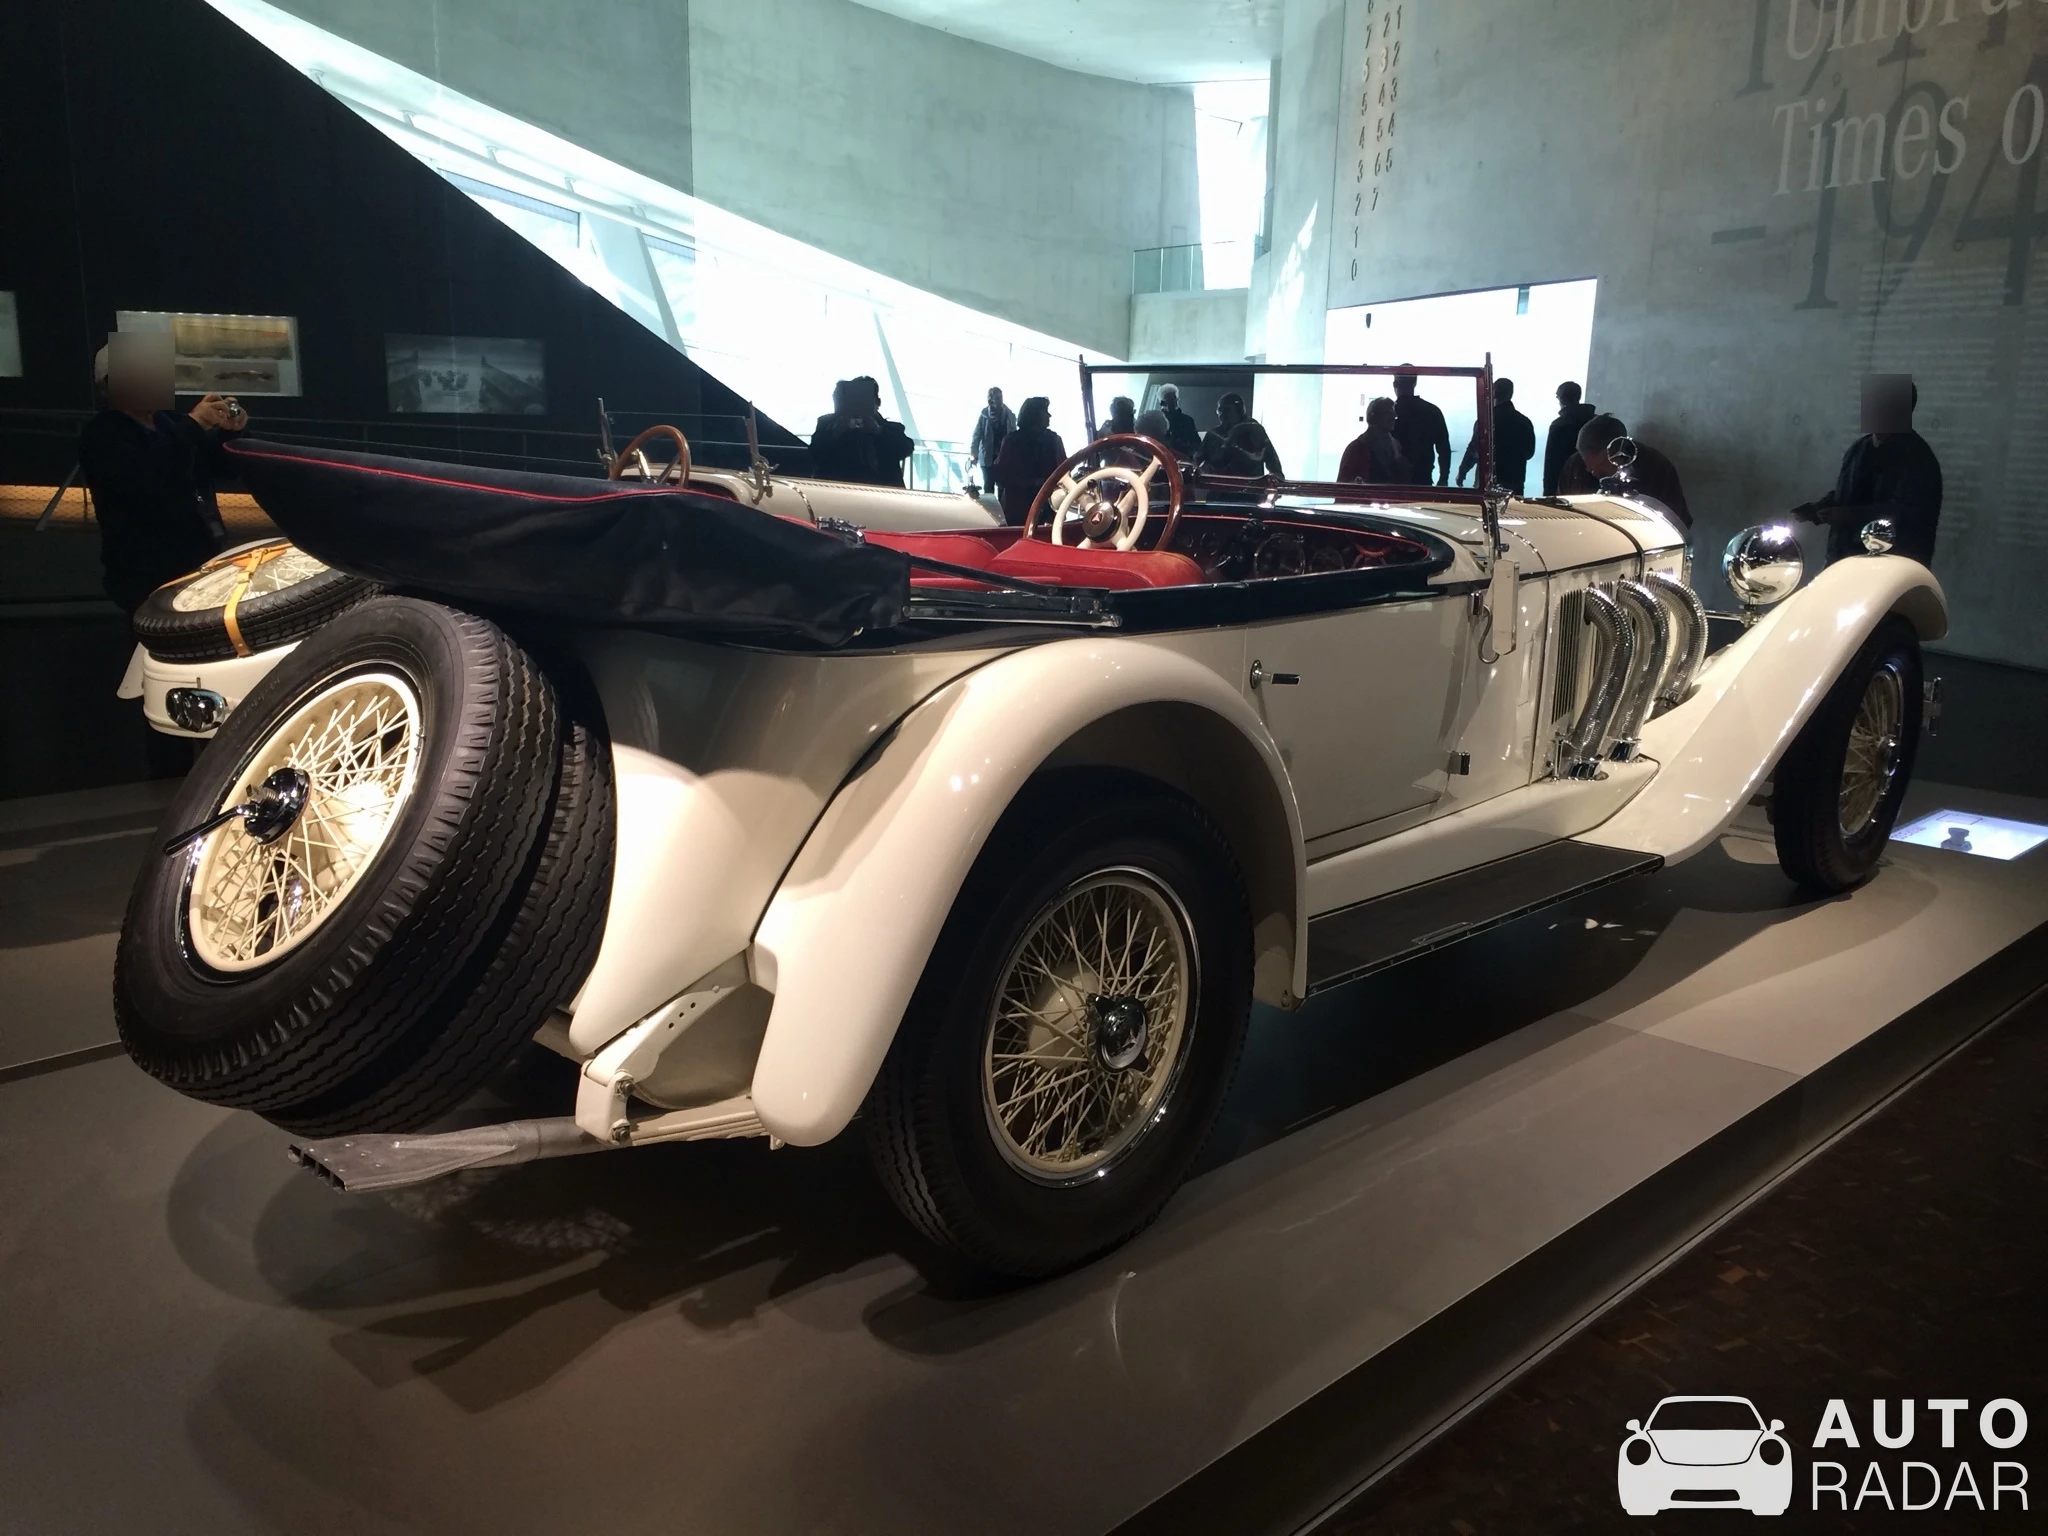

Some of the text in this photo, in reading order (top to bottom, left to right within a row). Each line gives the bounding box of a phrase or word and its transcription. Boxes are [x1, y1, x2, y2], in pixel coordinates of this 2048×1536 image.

[1379, 46, 1389, 73] 3
[1390, 77, 1398, 102] 3
[1361, 92, 1369, 116] 5
[1376, 117, 1384, 142] 5
[1772, 95, 1970, 196] Times
[1356, 159, 1364, 183] 3
[1374, 152, 1382, 177] 6
[1385, 147, 1394, 172] 5
[1351, 258, 1358, 281] 0
